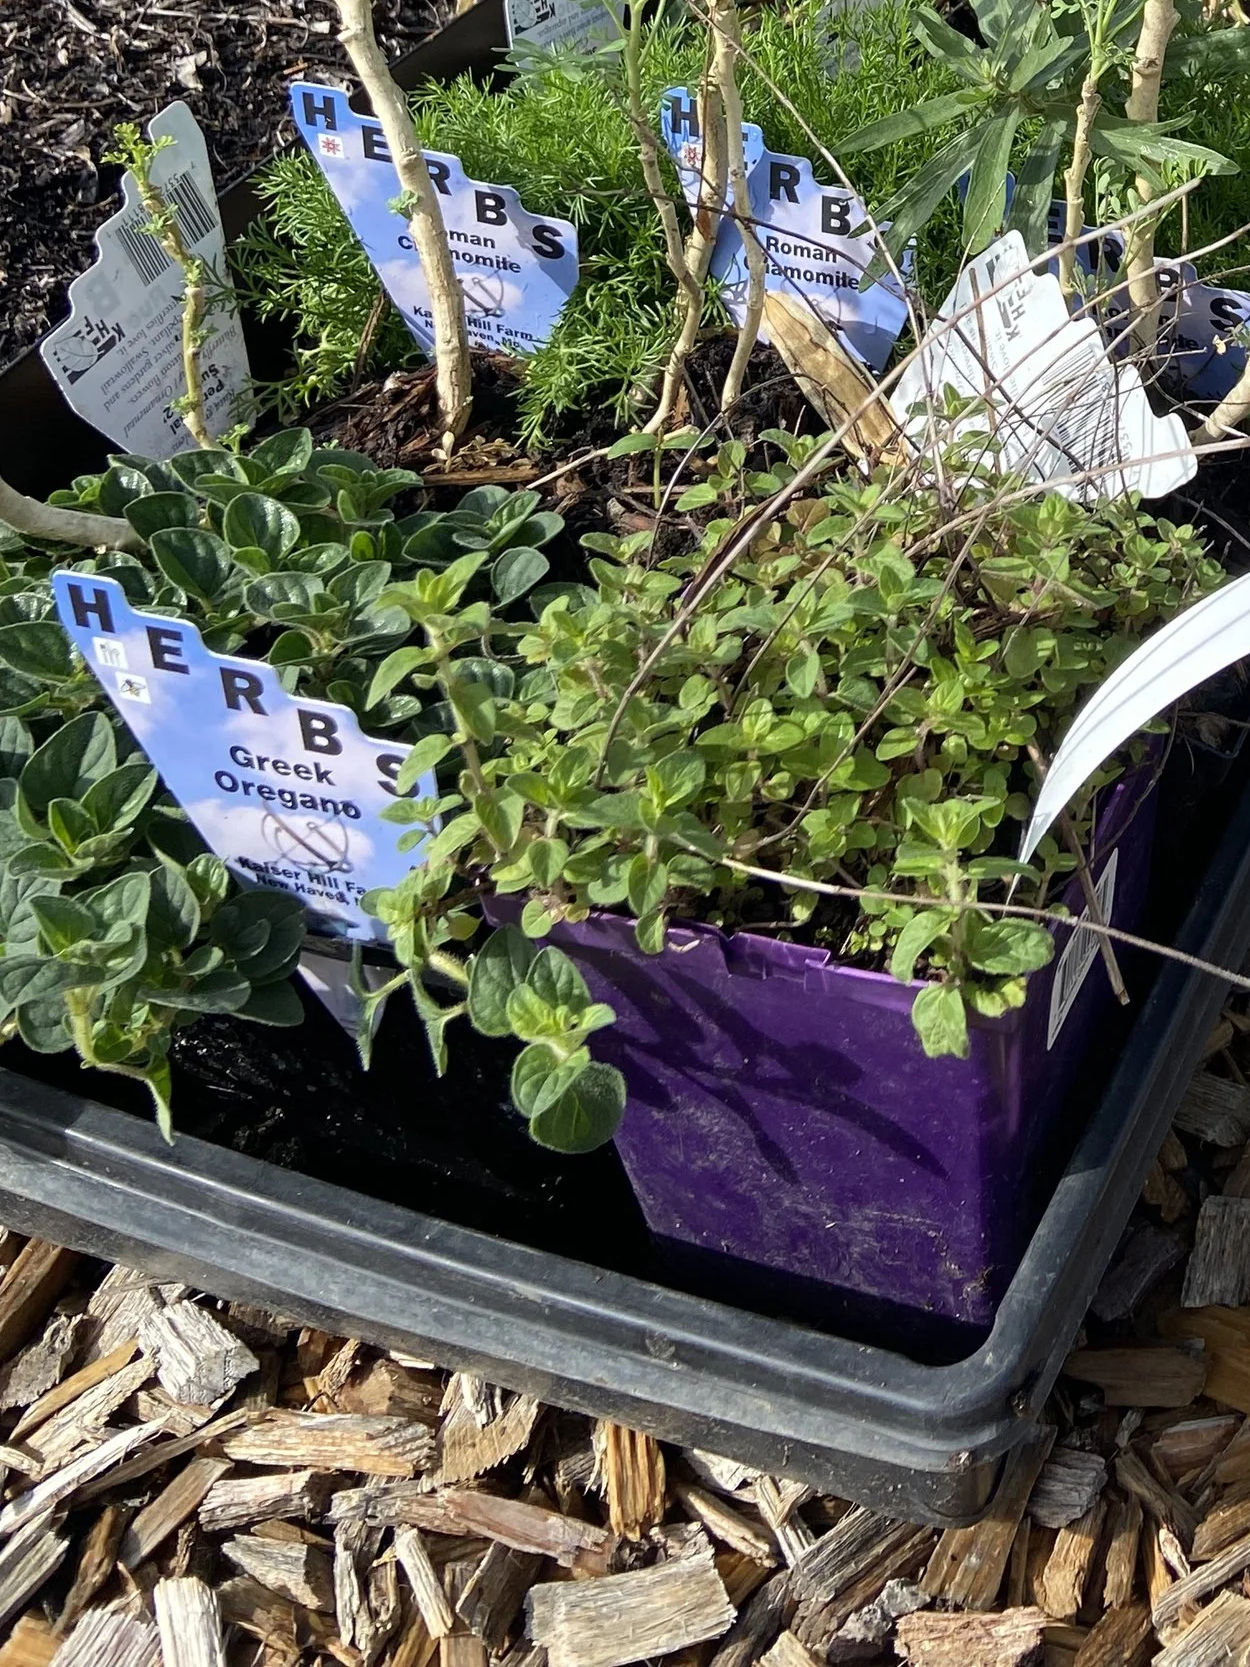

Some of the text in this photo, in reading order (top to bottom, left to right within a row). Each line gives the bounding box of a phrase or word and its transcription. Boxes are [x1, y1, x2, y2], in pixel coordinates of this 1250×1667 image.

[765, 235, 838, 264] Roman
[496, 324, 533, 341] Farm
[229, 745, 337, 787] Greek
[214, 770, 362, 820] Oregano
[307, 870, 340, 889] Hill
